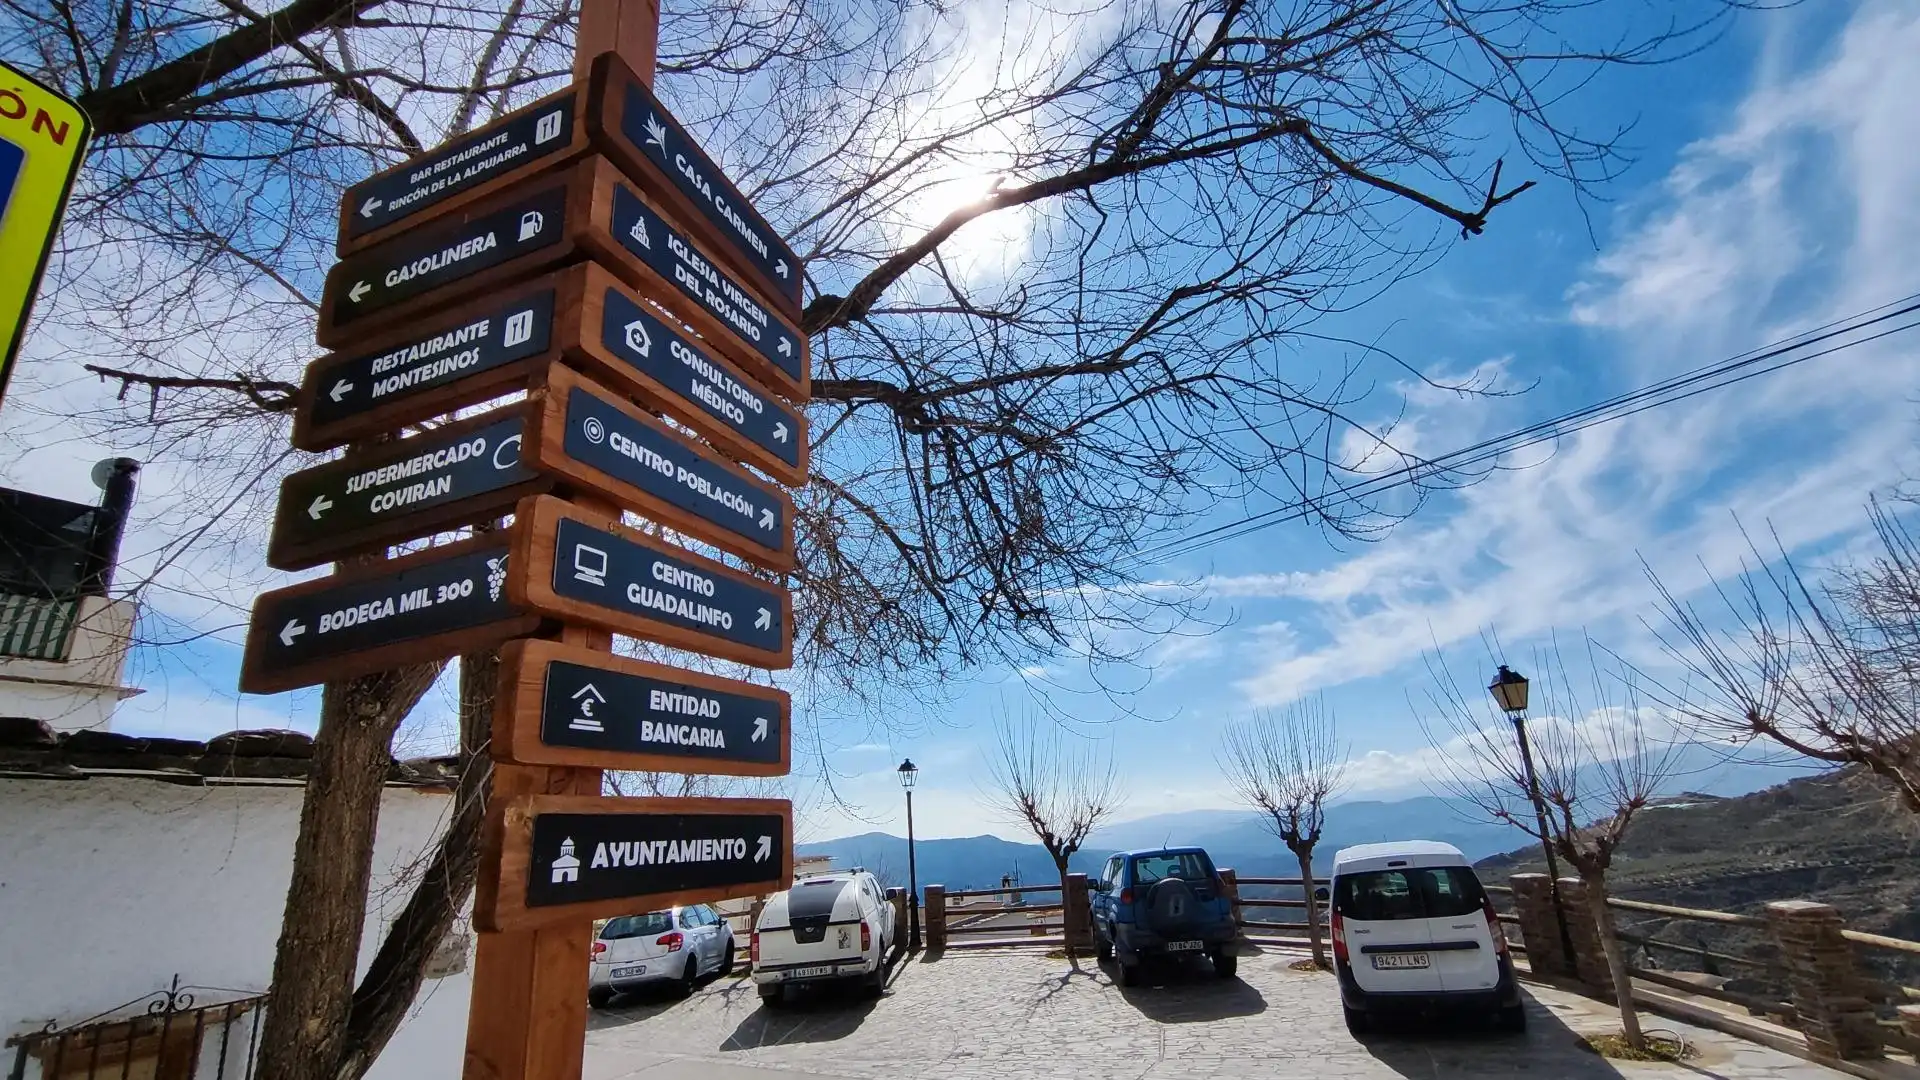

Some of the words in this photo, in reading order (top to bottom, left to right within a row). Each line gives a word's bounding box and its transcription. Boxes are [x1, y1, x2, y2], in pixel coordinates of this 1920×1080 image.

[388, 186, 429, 212] RINCÓN
[431, 179, 446, 194] DE
[447, 172, 461, 186] LA
[463, 142, 527, 179] ALPUJARRA
[410, 167, 432, 184] BAR
[434, 132, 508, 174] RESTAURANTE
[675, 153, 712, 202] CASA
[714, 196, 768, 259] CARMEN
[385, 231, 497, 287] GASOLINERA
[667, 234, 719, 288] IGLESIA
[722, 279, 768, 328] VIRGEN
[675, 263, 702, 298] DEL
[705, 289, 761, 342] ROSARIO
[370, 319, 490, 376] RESTAURANTE
[371, 347, 480, 398] MONTESINOS
[670, 340, 763, 414] CONSULTORIO
[691, 379, 744, 425] MÉDICO
[345, 438, 487, 495] SUPERMERCADO
[609, 431, 674, 477] CENTRO
[677, 466, 754, 519] POBLACIÓN
[370, 475, 452, 514] COVIRAN
[318, 597, 395, 634] BODEGA
[399, 587, 433, 614] MIL
[436, 578, 474, 604] 300
[652, 561, 715, 597] CENTRO
[627, 583, 733, 630] GUADALINFO
[649, 689, 721, 719] ENTIDAD
[641, 720, 726, 749] BANCARIA
[590, 837, 747, 869] AYUNTAMIENTO
[1377, 955, 1403, 967] 9421
[1406, 955, 1428, 966] LNS
